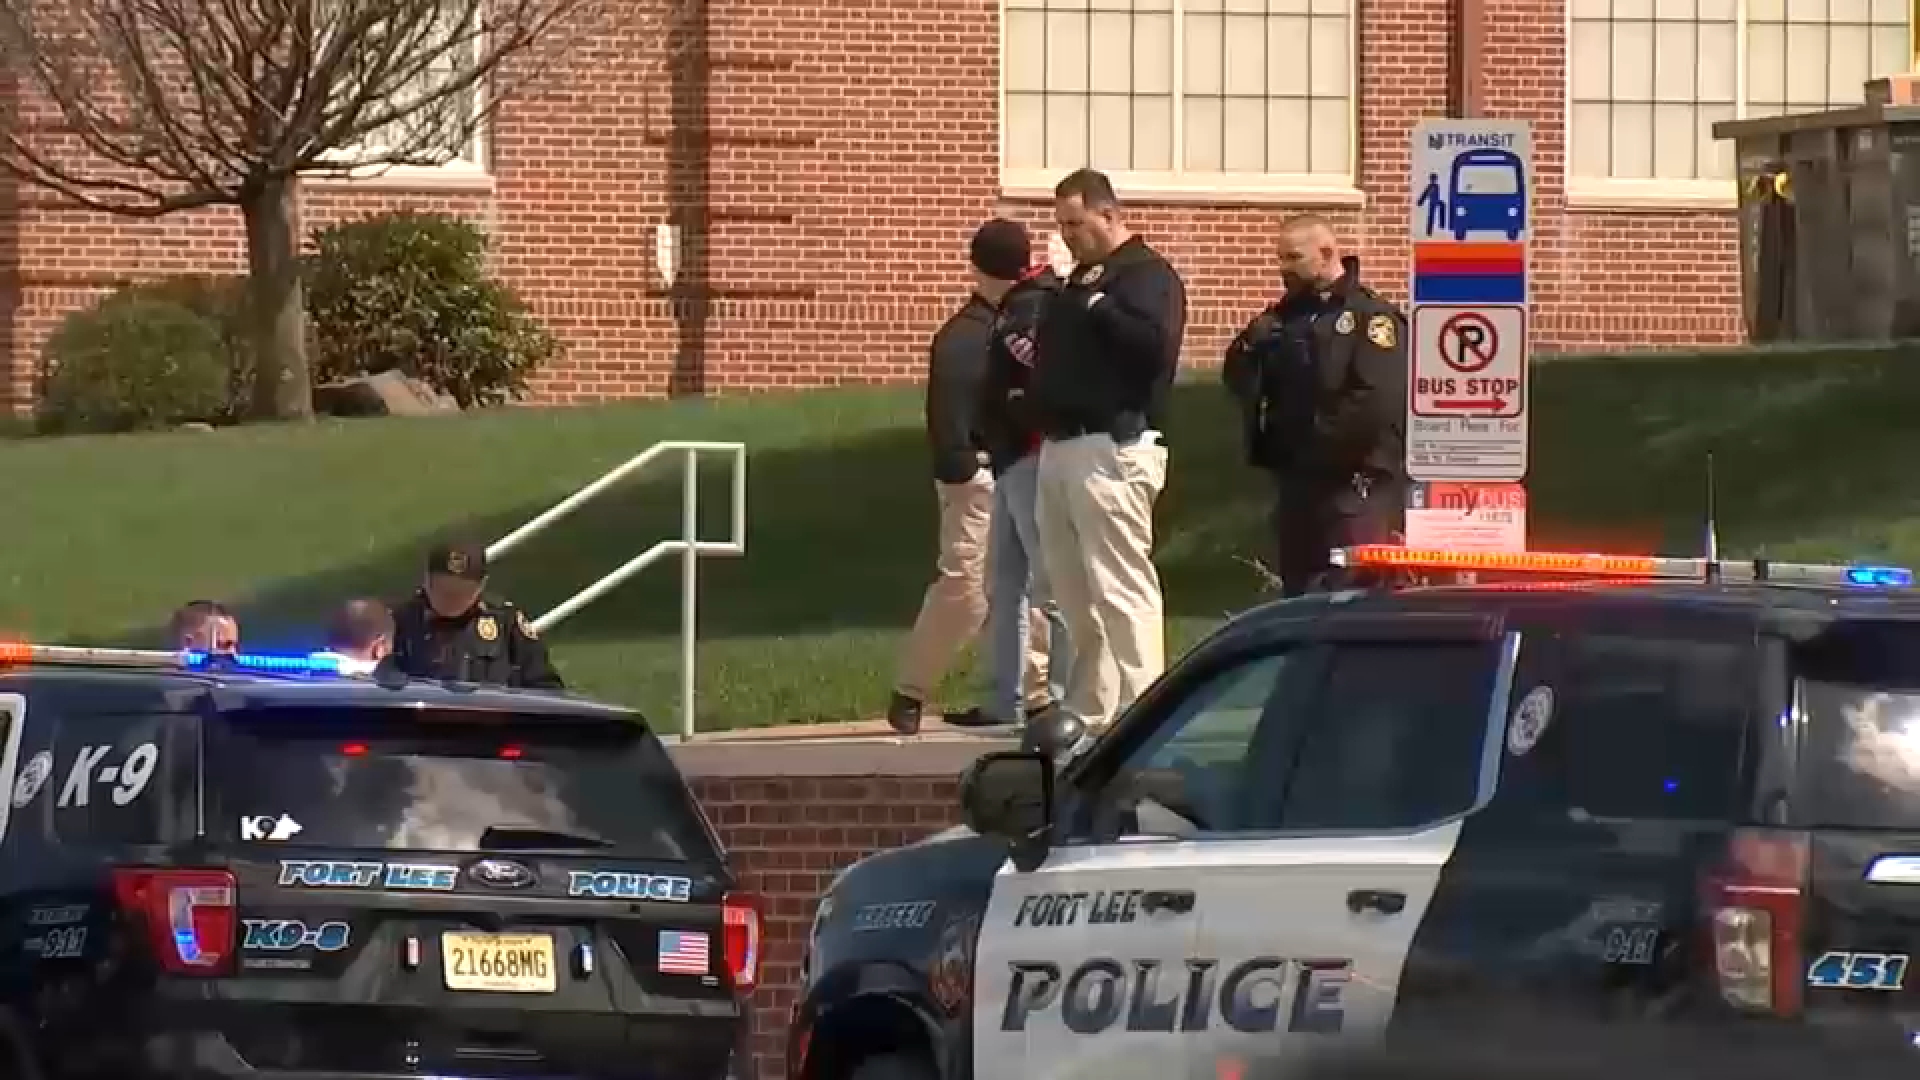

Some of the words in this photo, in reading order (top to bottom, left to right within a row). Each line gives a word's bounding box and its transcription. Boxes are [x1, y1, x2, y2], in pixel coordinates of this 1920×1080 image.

[1448, 133, 1516, 147] TRANSIT
[1417, 377, 1456, 395] BUS
[1466, 377, 1519, 395] STOP
[58, 743, 159, 807] K-9
[278, 859, 382, 887] FORT
[384, 863, 461, 890] LEE
[567, 871, 692, 902] POLICE
[1015, 892, 1089, 928] FORT
[1087, 889, 1144, 924] LEE
[452, 947, 547, 978] 21668MG
[1808, 951, 1911, 991] 451
[1000, 956, 1354, 1034] POLICE
